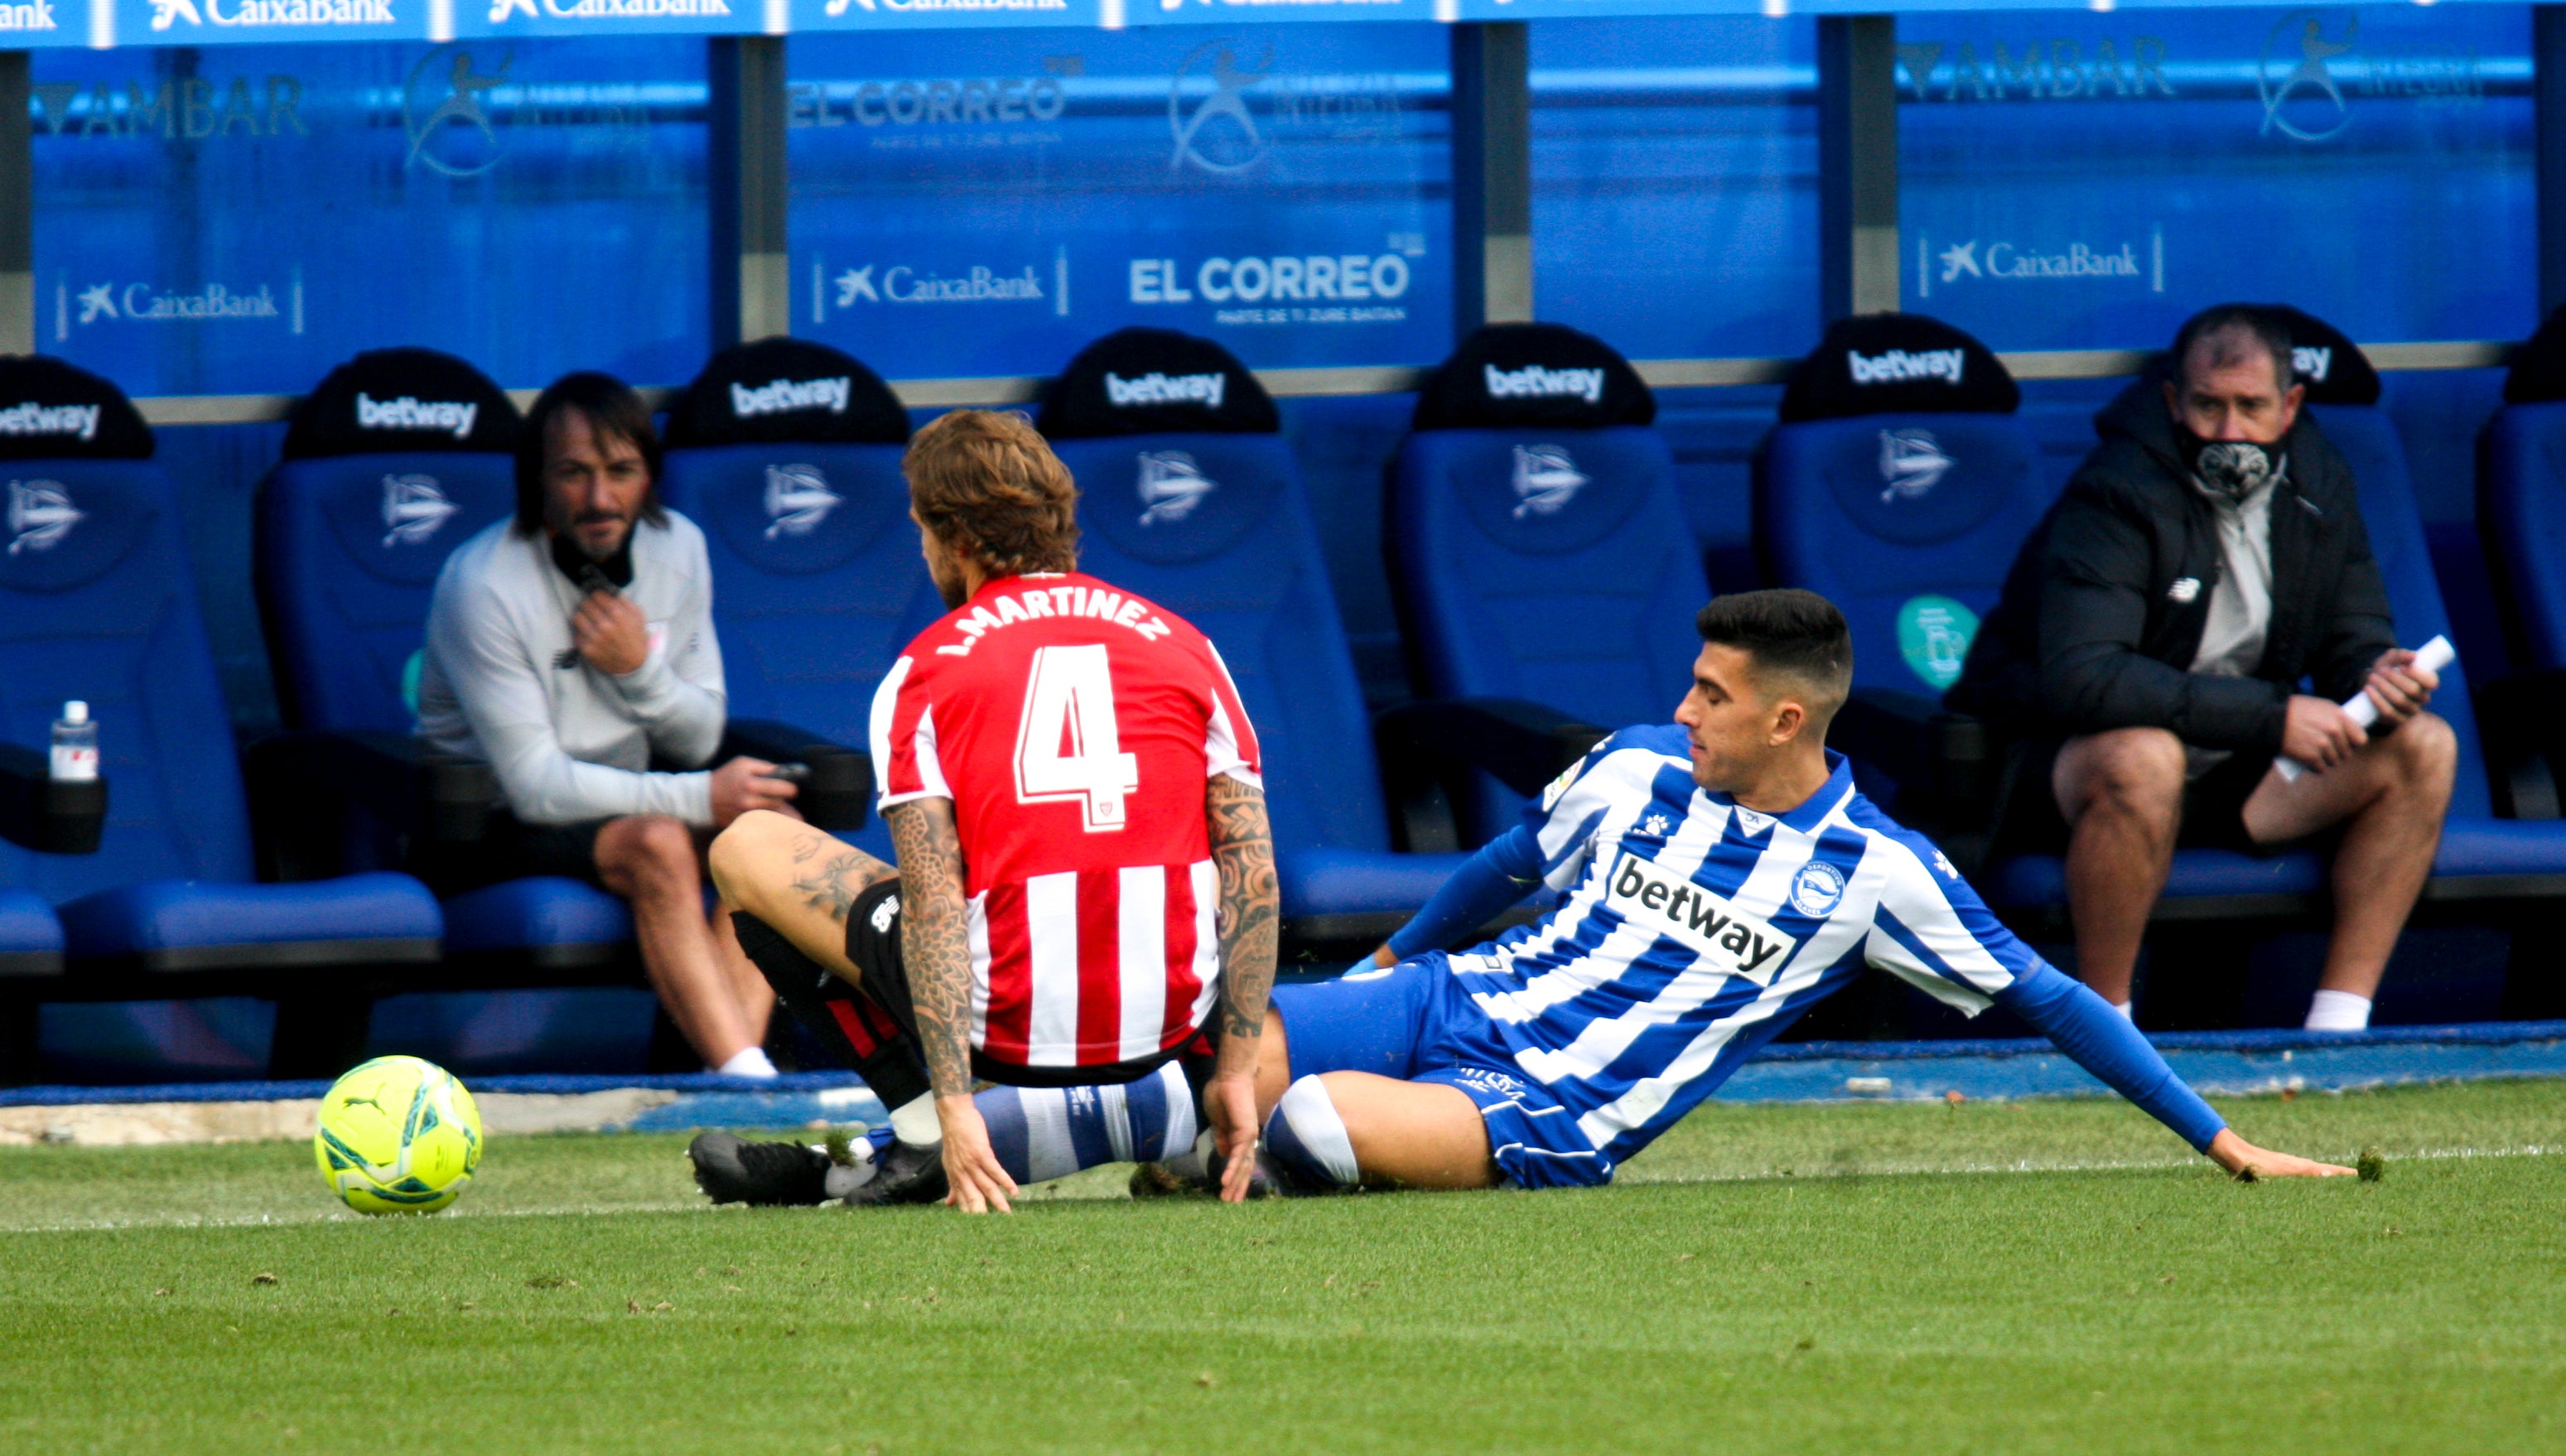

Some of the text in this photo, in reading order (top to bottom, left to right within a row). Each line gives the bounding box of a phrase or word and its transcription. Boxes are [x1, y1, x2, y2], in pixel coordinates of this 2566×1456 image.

[1946, 35, 2176, 100] AMBAR
[79, 75, 310, 140] AMBAR
[853, 80, 1066, 126] CORREO
[1130, 253, 1409, 304] EL CORREO
[1985, 241, 2140, 279] CaixaBank
[123, 282, 279, 320] CaixaBank
[883, 265, 1044, 304] CaixaBank
[1484, 363, 1604, 403] betway
[1848, 348, 1963, 384] betway
[731, 375, 851, 417] betway
[1106, 371, 1225, 409] betway
[0, 402, 101, 441] etway
[358, 392, 478, 438] betway
[936, 586, 1171, 656] I.MARTINEZ
[1013, 643, 1139, 834] 4
[1616, 856, 1782, 972] betway
